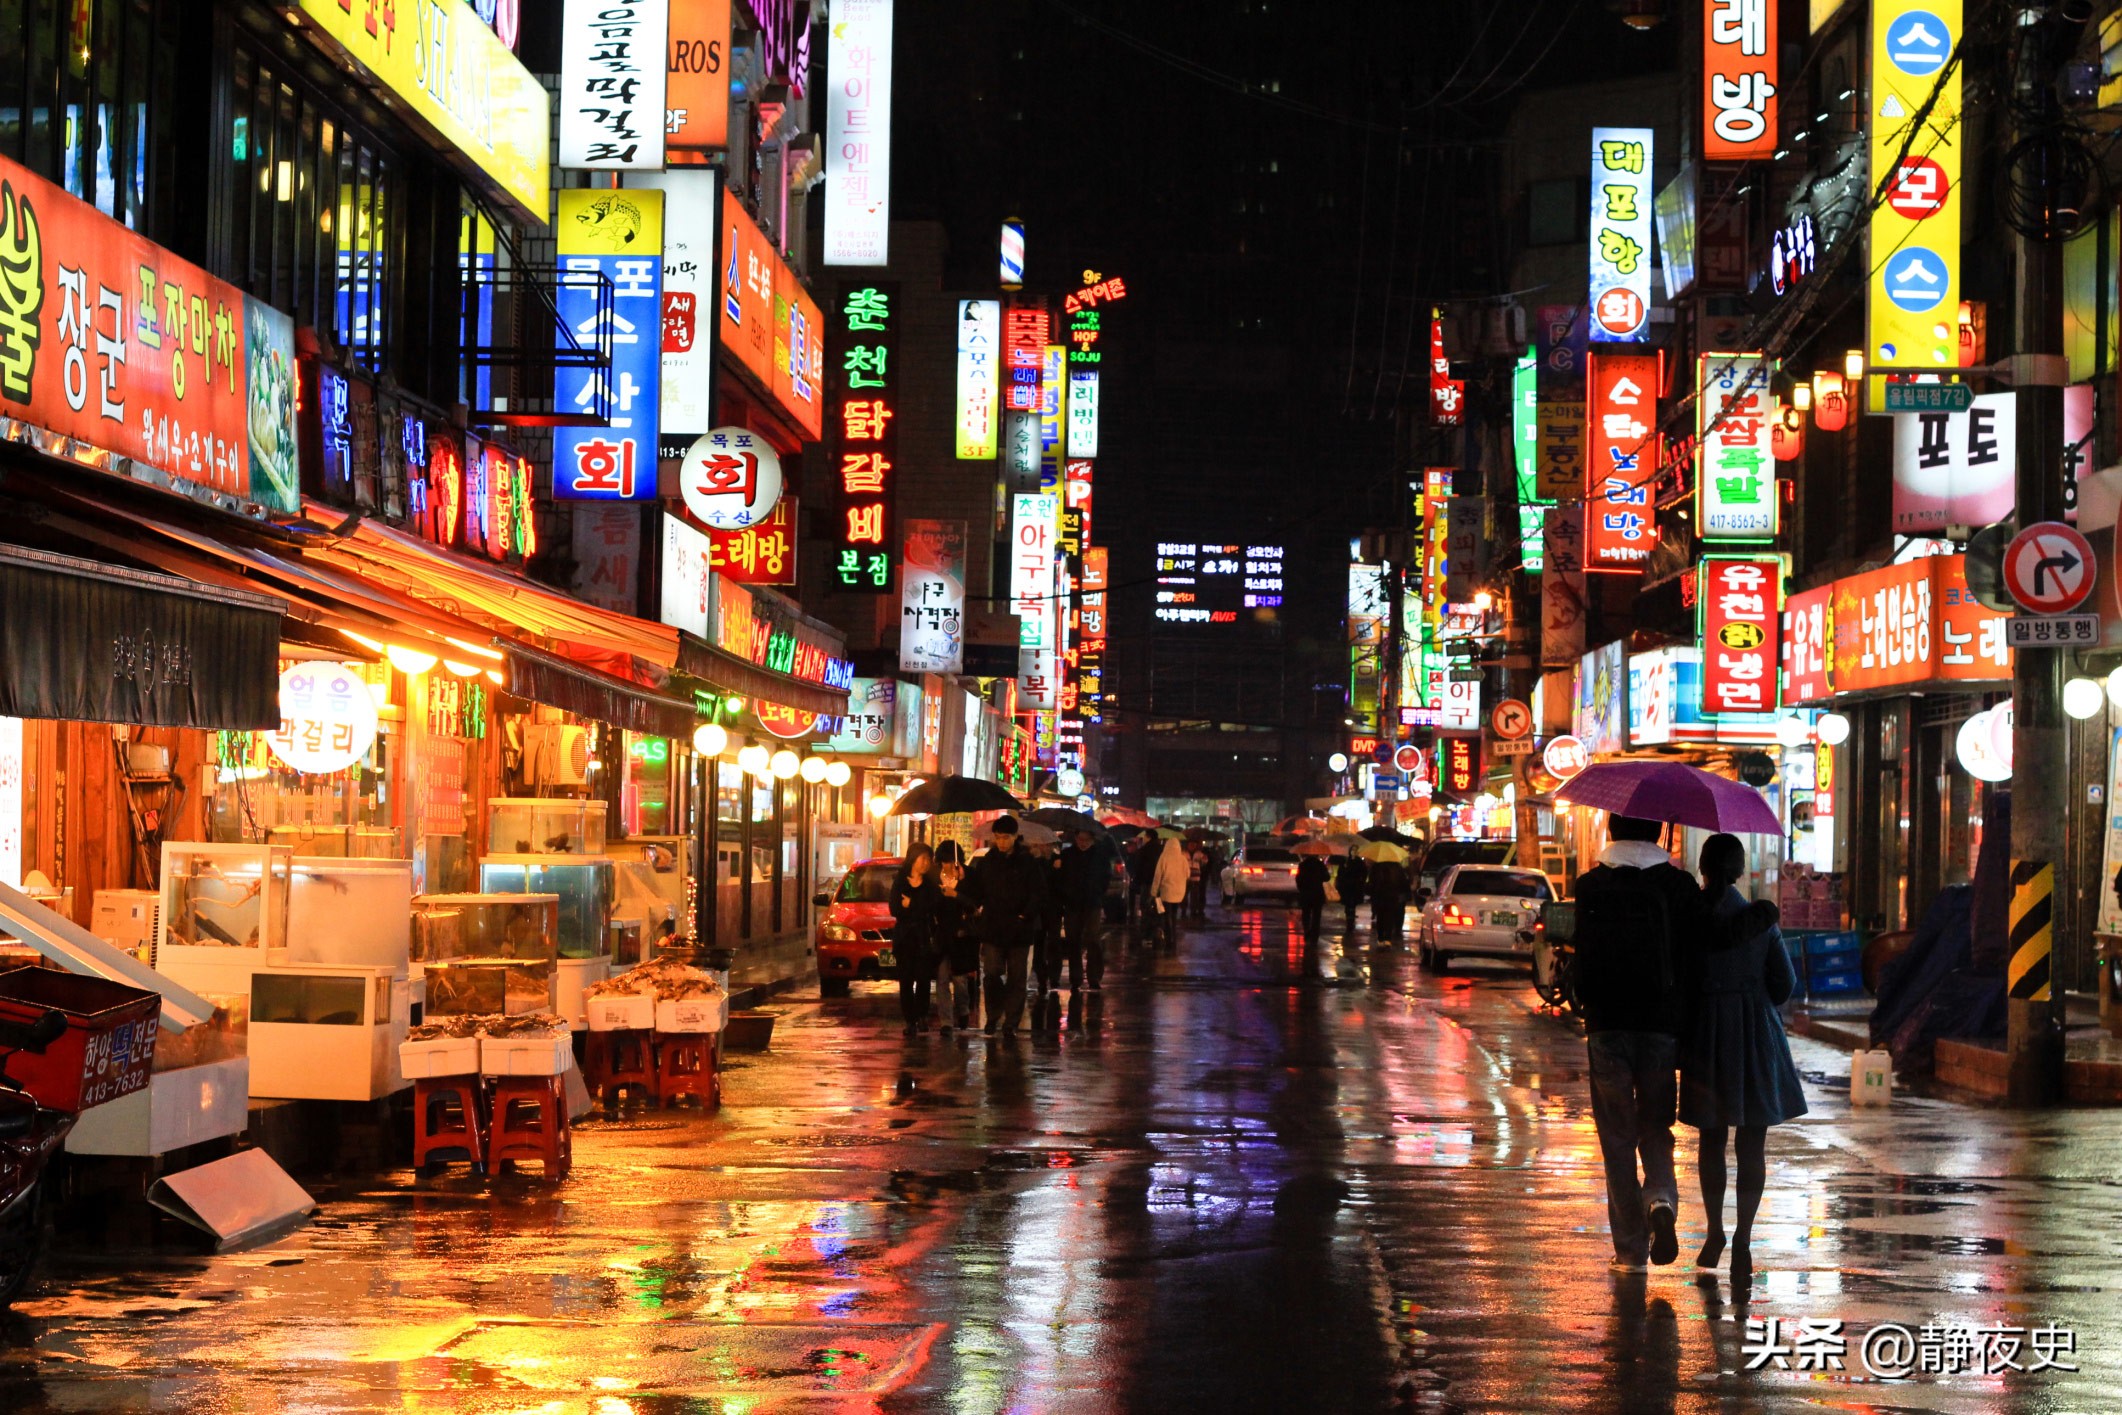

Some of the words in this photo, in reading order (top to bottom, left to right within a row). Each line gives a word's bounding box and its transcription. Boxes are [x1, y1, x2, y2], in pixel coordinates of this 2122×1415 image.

[840, 45, 877, 207] 화이트엔젤
[1598, 140, 1645, 275] 대포항
[565, 258, 655, 301] 목포
[1064, 277, 1127, 314] 스카이존
[1083, 269, 1102, 285] 9F
[56, 262, 127, 424] 장군
[137, 264, 237, 401] 포장마차
[1074, 331, 1098, 342] HOF
[573, 306, 641, 429] 수산
[1069, 351, 1101, 363] SOJU
[1714, 394, 1766, 446] 보쌈
[1918, 408, 1999, 469] 포토
[710, 433, 754, 449] 목포
[963, 446, 990, 457] 3F
[1545, 424, 1583, 484] 부동산
[572, 437, 638, 498] 회
[695, 450, 760, 508] 회
[1714, 447, 1767, 505] 족발
[1018, 498, 1051, 518] 초원
[1603, 447, 1647, 540] 노래방
[708, 509, 753, 525] 수산
[837, 549, 889, 586] 본점
[903, 606, 960, 635] 사격장
[2014, 621, 2092, 640] 일방통행
[287, 674, 353, 710] 얼음
[1449, 680, 1475, 726] 아구
[275, 718, 354, 755] 막걸리
[1352, 739, 1376, 753] DVD
[1453, 739, 1470, 790] 노래방
[85, 1069, 149, 1104] 413-7632
